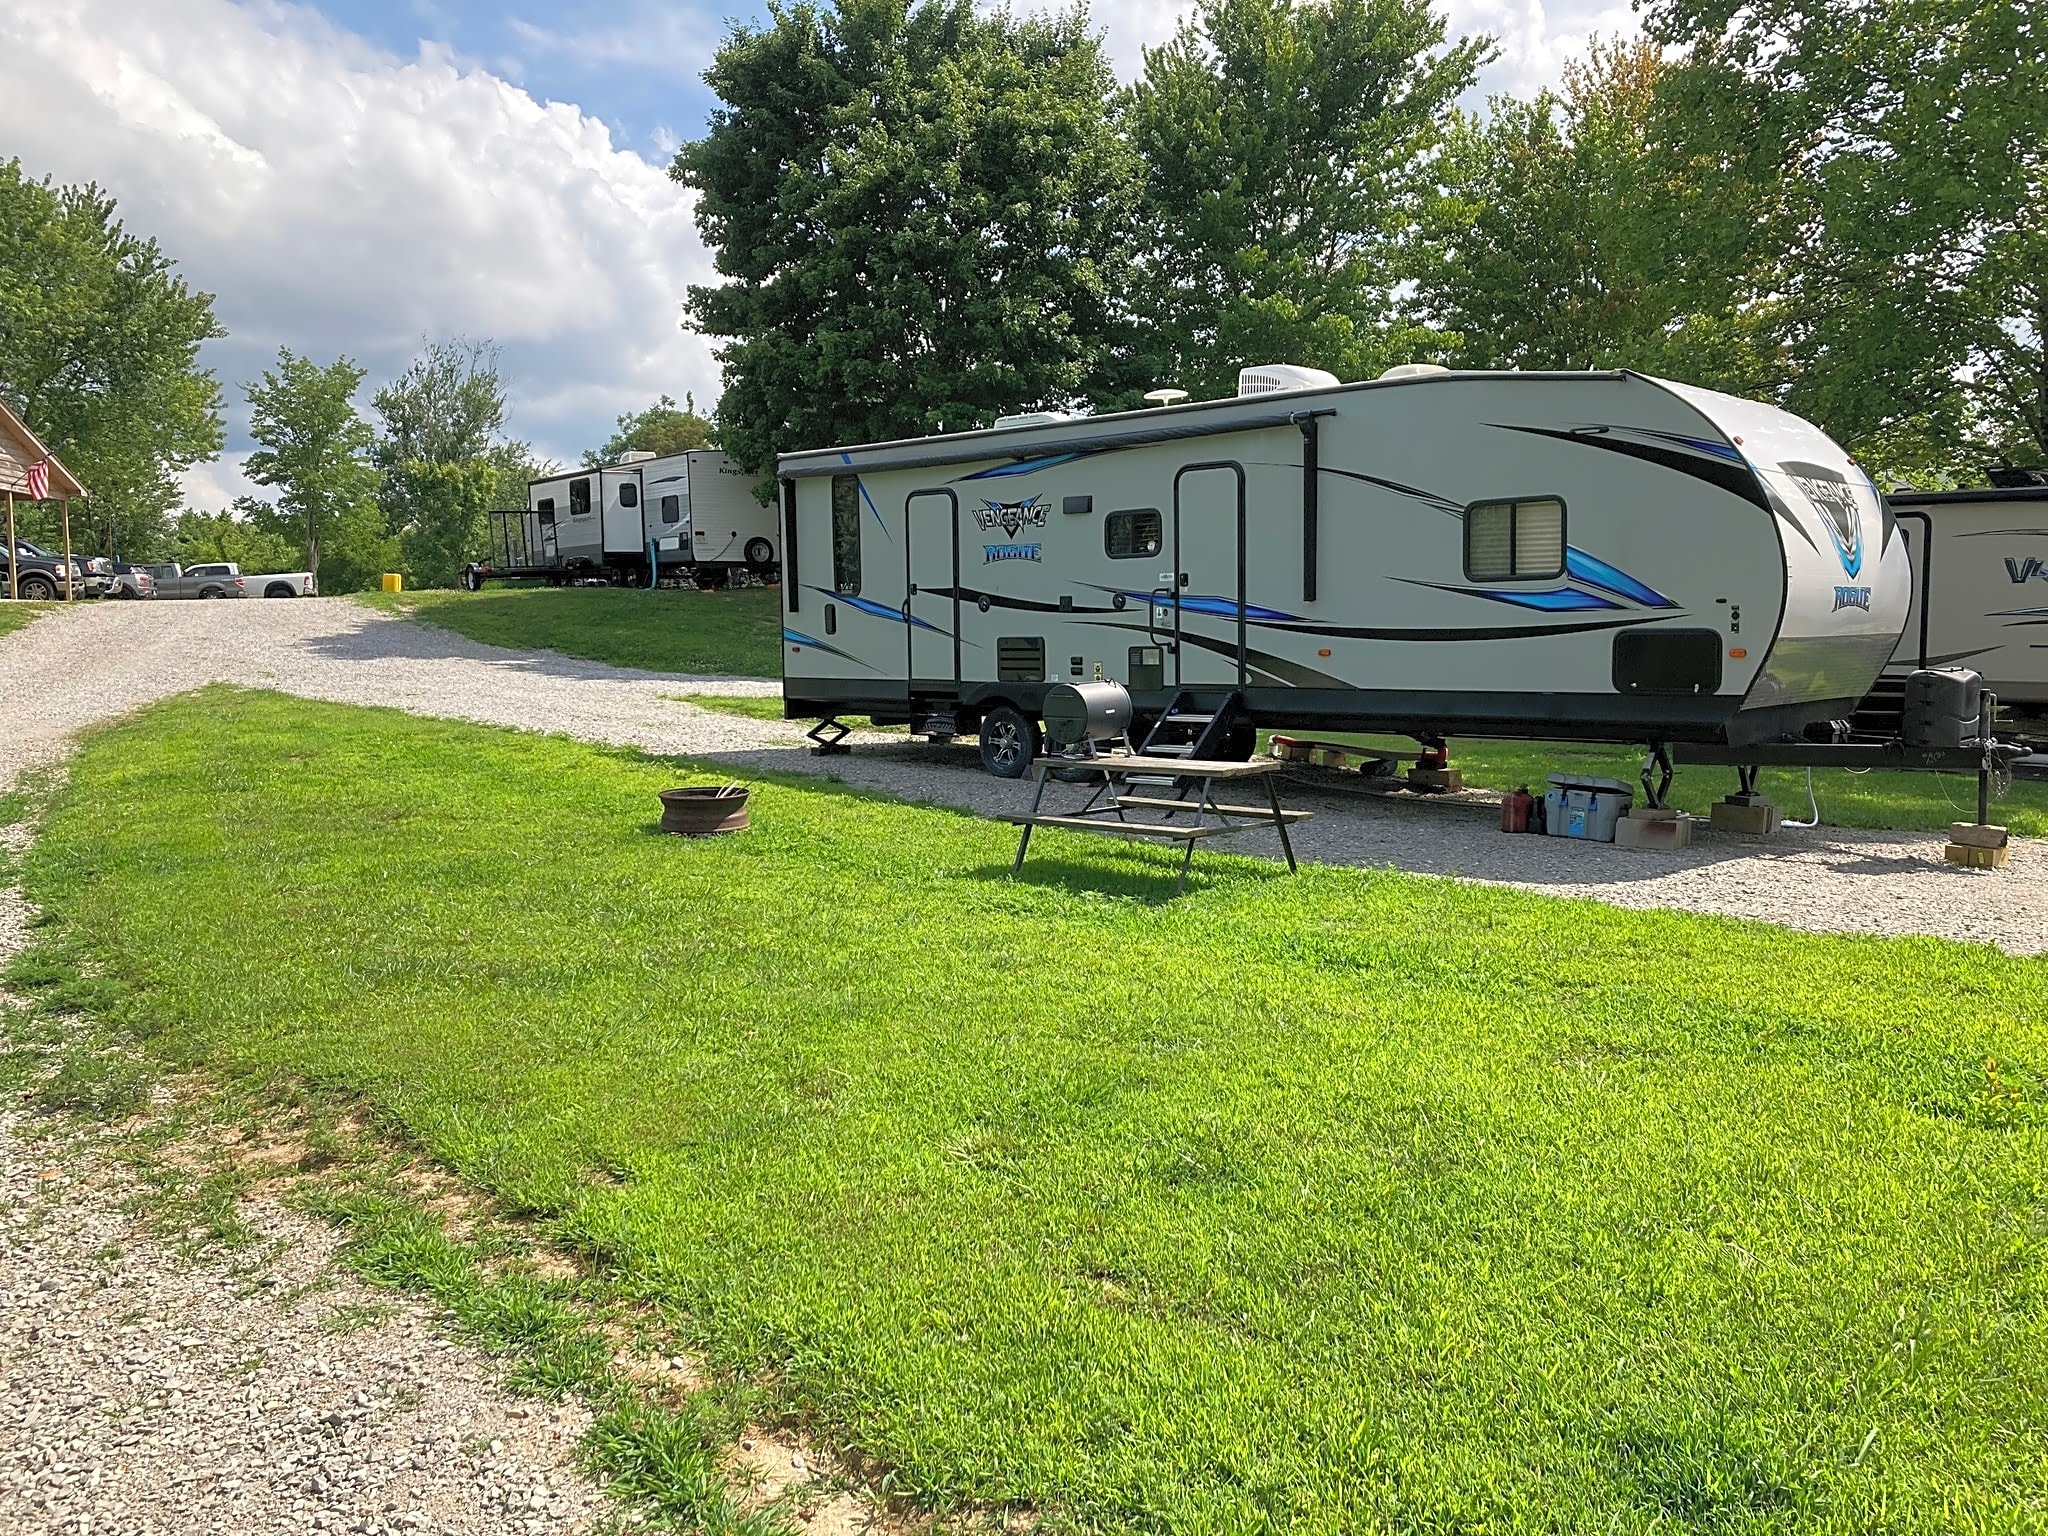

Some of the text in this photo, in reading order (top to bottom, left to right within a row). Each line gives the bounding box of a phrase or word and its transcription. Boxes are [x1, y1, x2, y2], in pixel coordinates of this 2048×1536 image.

[972, 504, 1052, 534] VENGEANCE
[983, 543, 1042, 565] ROGUE
[1832, 586, 1871, 613] ROGUE
